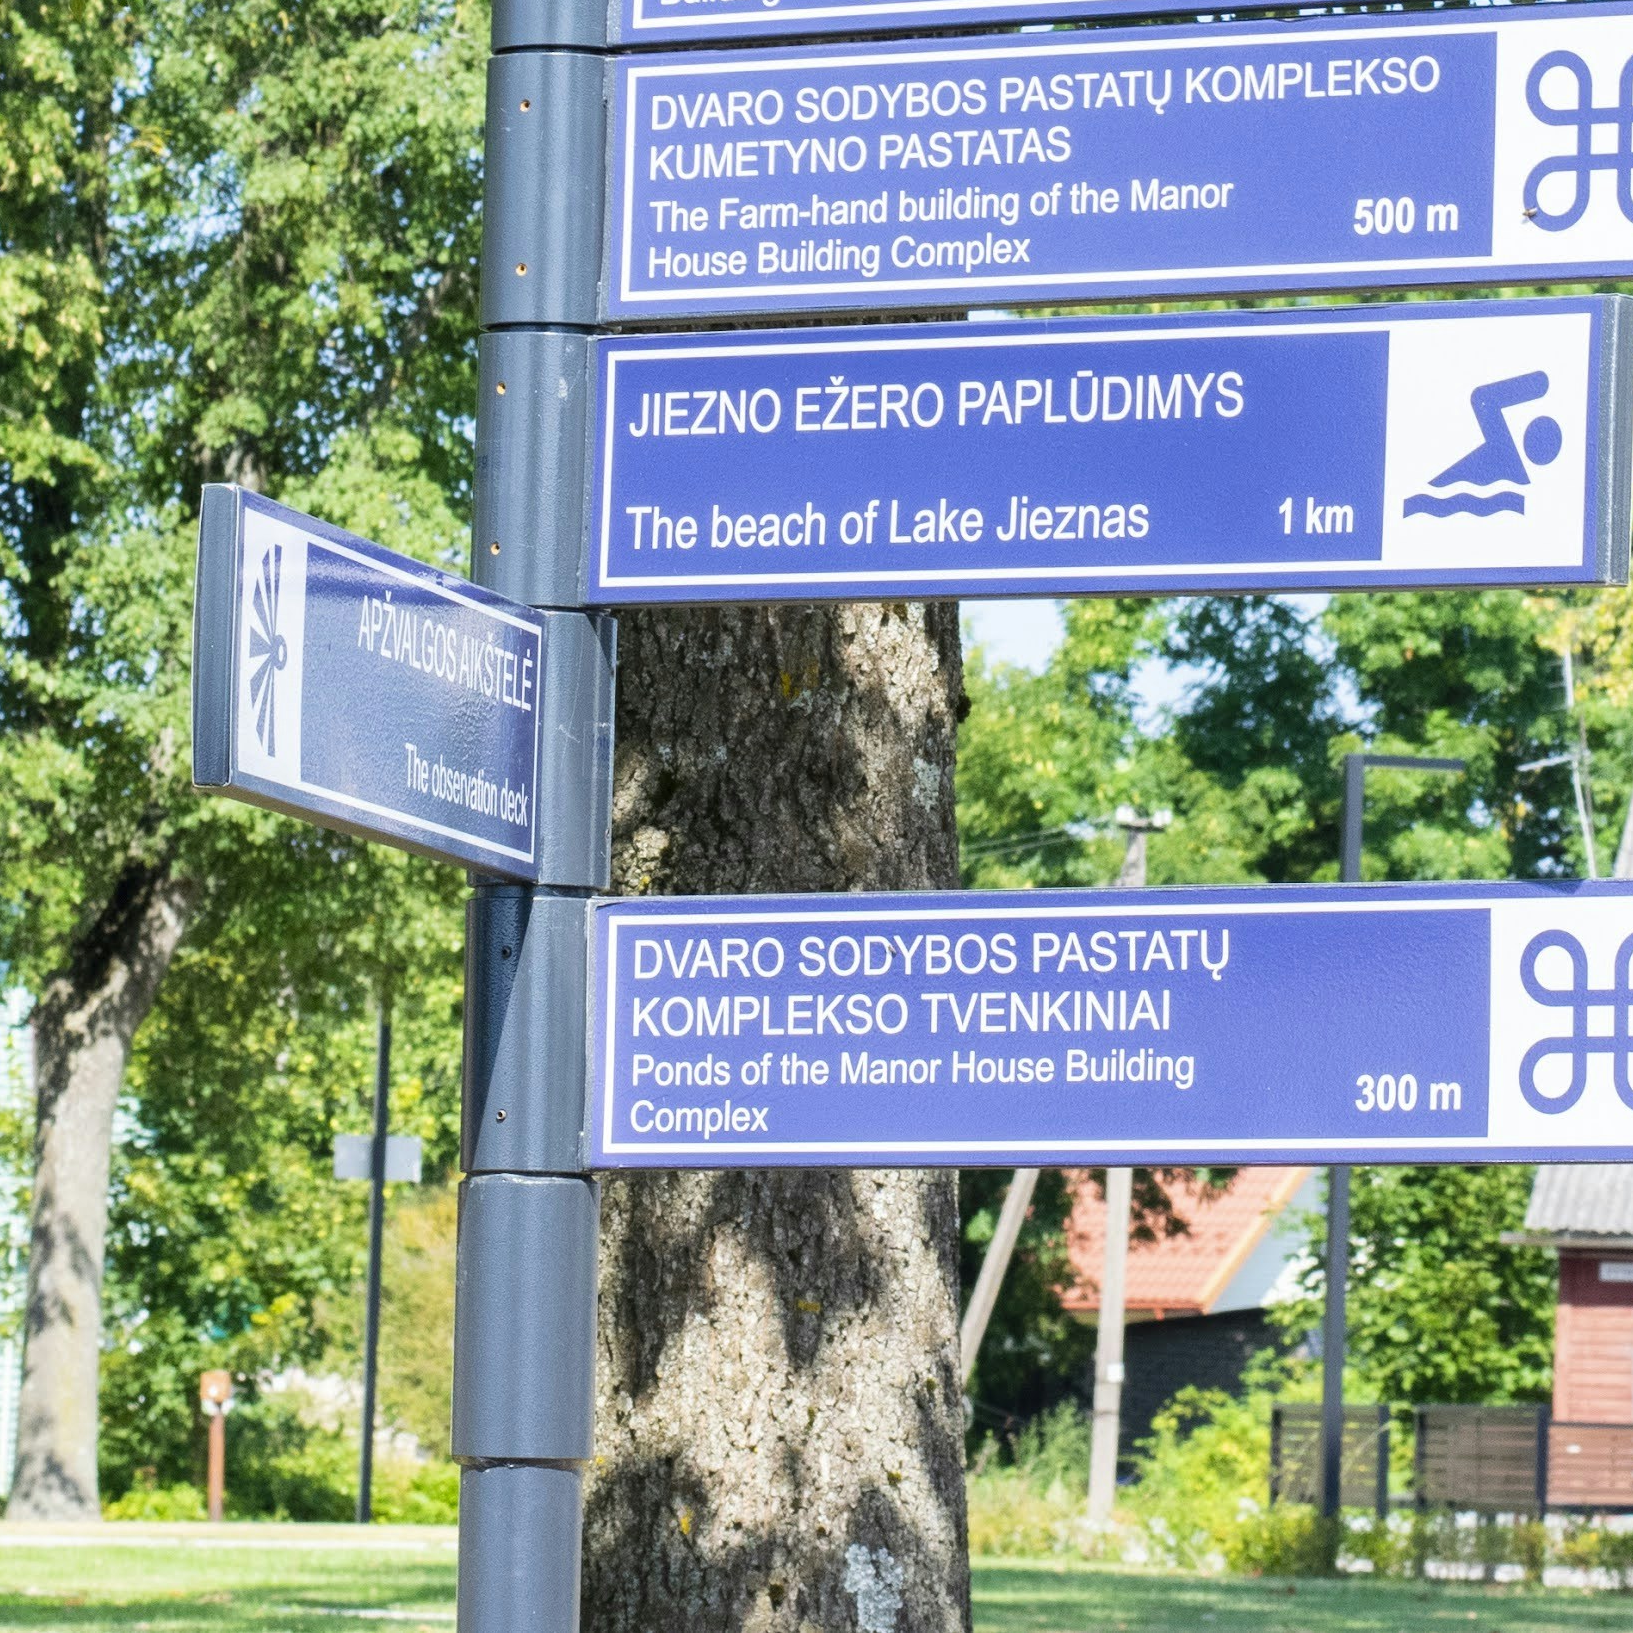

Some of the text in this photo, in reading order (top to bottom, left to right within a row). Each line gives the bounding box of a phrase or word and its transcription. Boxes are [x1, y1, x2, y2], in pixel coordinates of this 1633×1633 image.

[651, 55, 1440, 131] DVARO SODYBOS PASTATŲ KOMPLEKSO
[649, 125, 1072, 181] KUMETYNO PASTATAS
[649, 178, 1234, 233] The Farm-hand building of the Manor
[1353, 196, 1459, 236] 500 m
[648, 232, 1031, 279] House Building Complex
[629, 370, 1244, 438] JIEZNO EŽERO PAPLŪDIMYS
[625, 495, 1150, 550] The beach of Lake Jieznas
[1278, 496, 1354, 535] 1 km
[357, 590, 533, 712] APŽVALGOS AIKŠTELĖ
[404, 743, 529, 828] The observation deck
[634, 929, 1229, 981] DVARO SODYBOS PASTATŲ
[632, 989, 1170, 1037] KOMPLEKSO TVENKINIAI
[632, 1048, 1195, 1090] Ponds of the Manor House Building
[1355, 1073, 1462, 1112] 300 m
[630, 1099, 769, 1140] Complex
